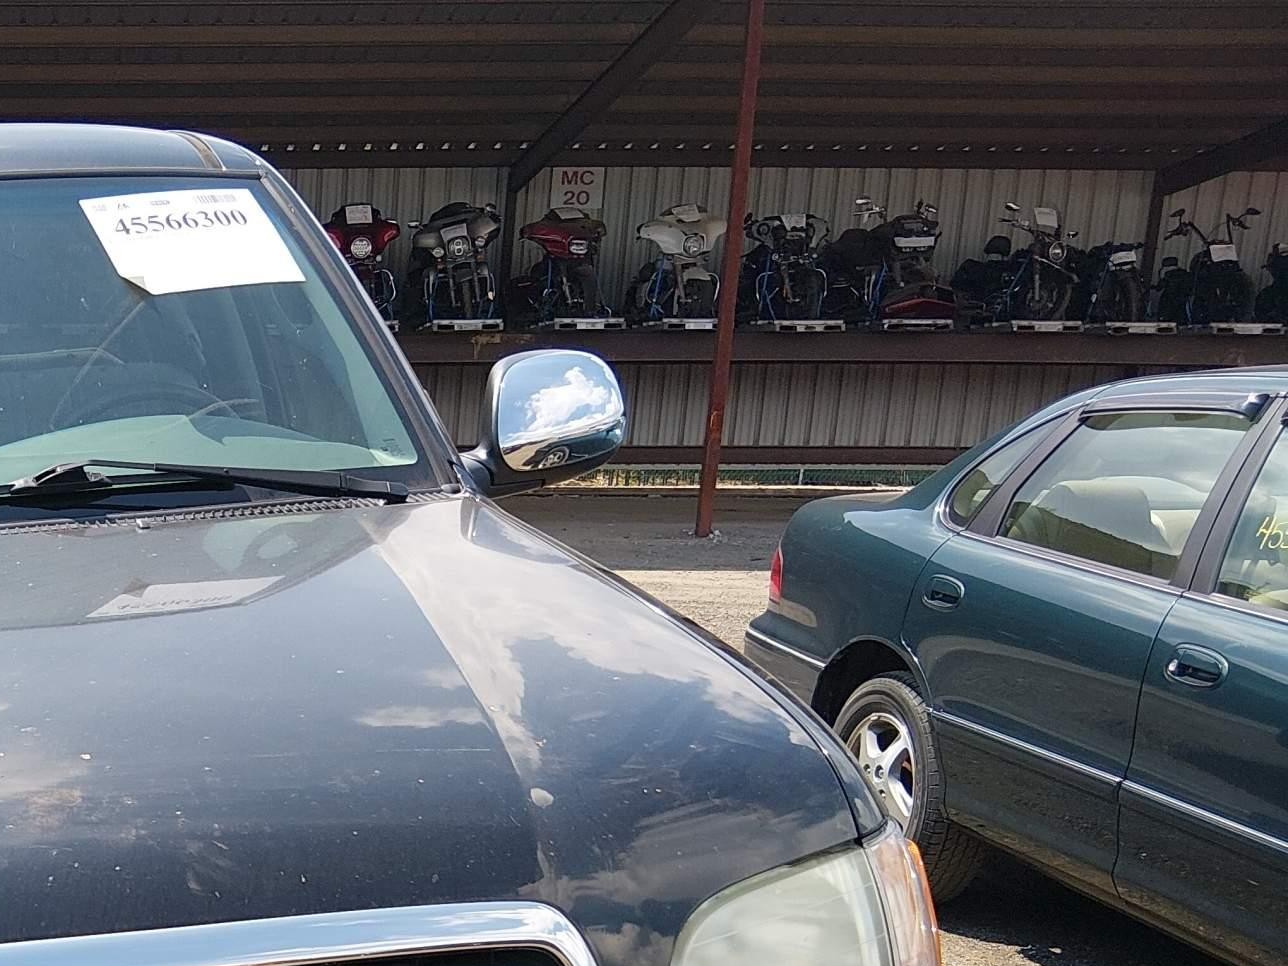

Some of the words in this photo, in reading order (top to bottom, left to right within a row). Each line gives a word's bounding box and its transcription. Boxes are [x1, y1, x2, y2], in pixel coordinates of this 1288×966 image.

[561, 170, 595, 186] MC
[562, 190, 590, 206] 20
[115, 209, 248, 236] 45566300
